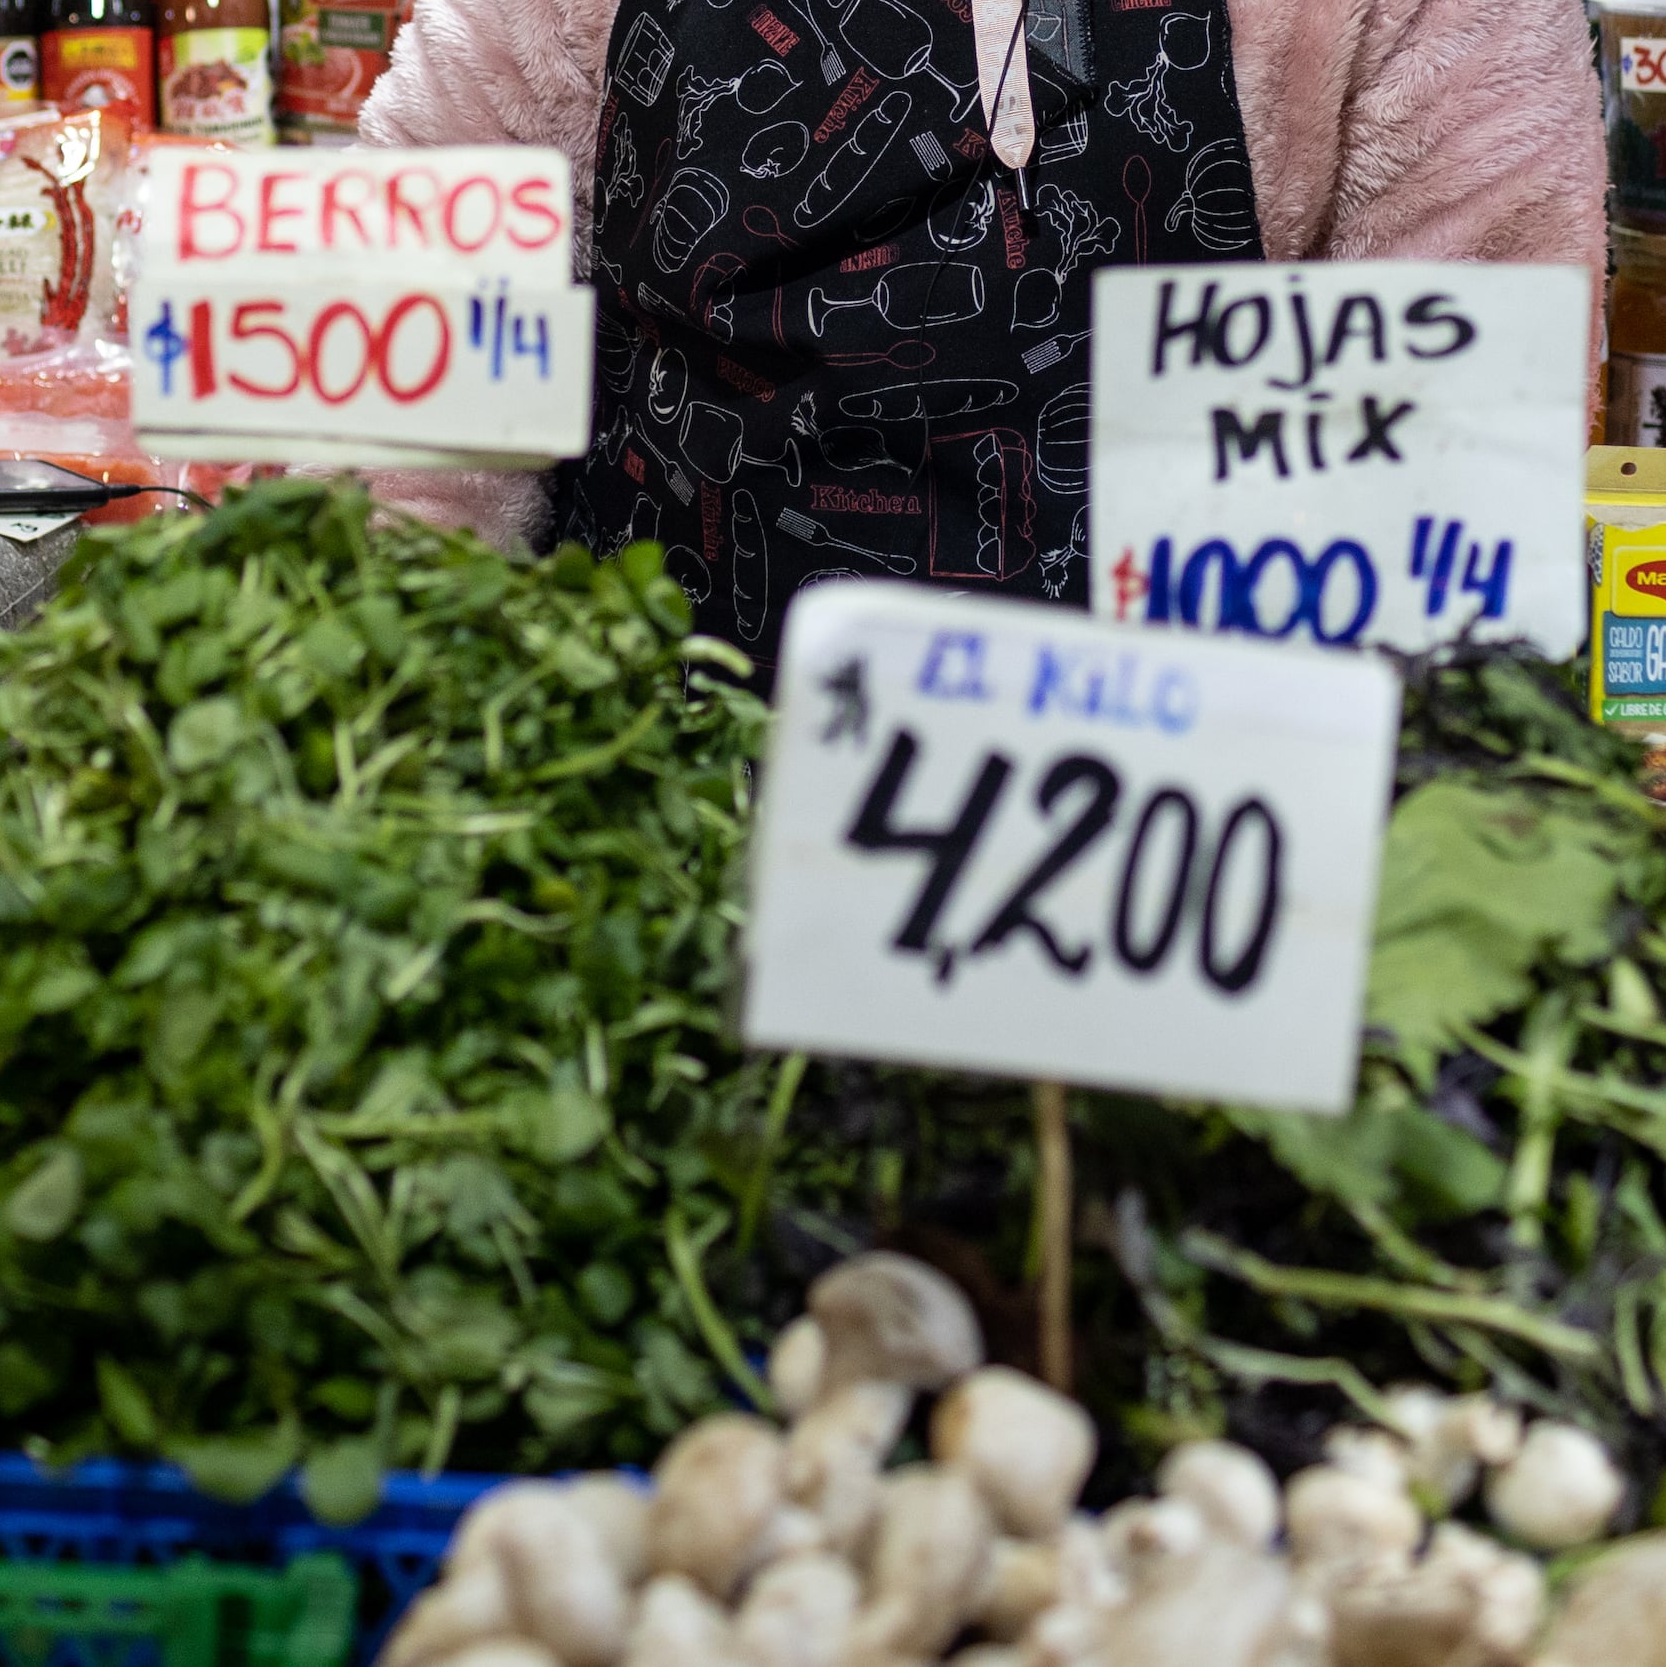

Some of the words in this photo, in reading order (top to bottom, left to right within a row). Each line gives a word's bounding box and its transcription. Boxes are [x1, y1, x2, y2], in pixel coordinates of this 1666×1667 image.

[175, 163, 565, 261] BERROS
[143, 292, 455, 408] $1500
[467, 276, 553, 384] 1/4
[809, 483, 922, 515] Kitchen
[1110, 534, 1380, 646] $1000
[1408, 513, 1517, 624] 1/4
[1608, 626, 1643, 649] CALDO
[1608, 660, 1644, 684] SABOR
[1619, 702, 1649, 716] LIBRE
[1649, 702, 1663, 716] DE
